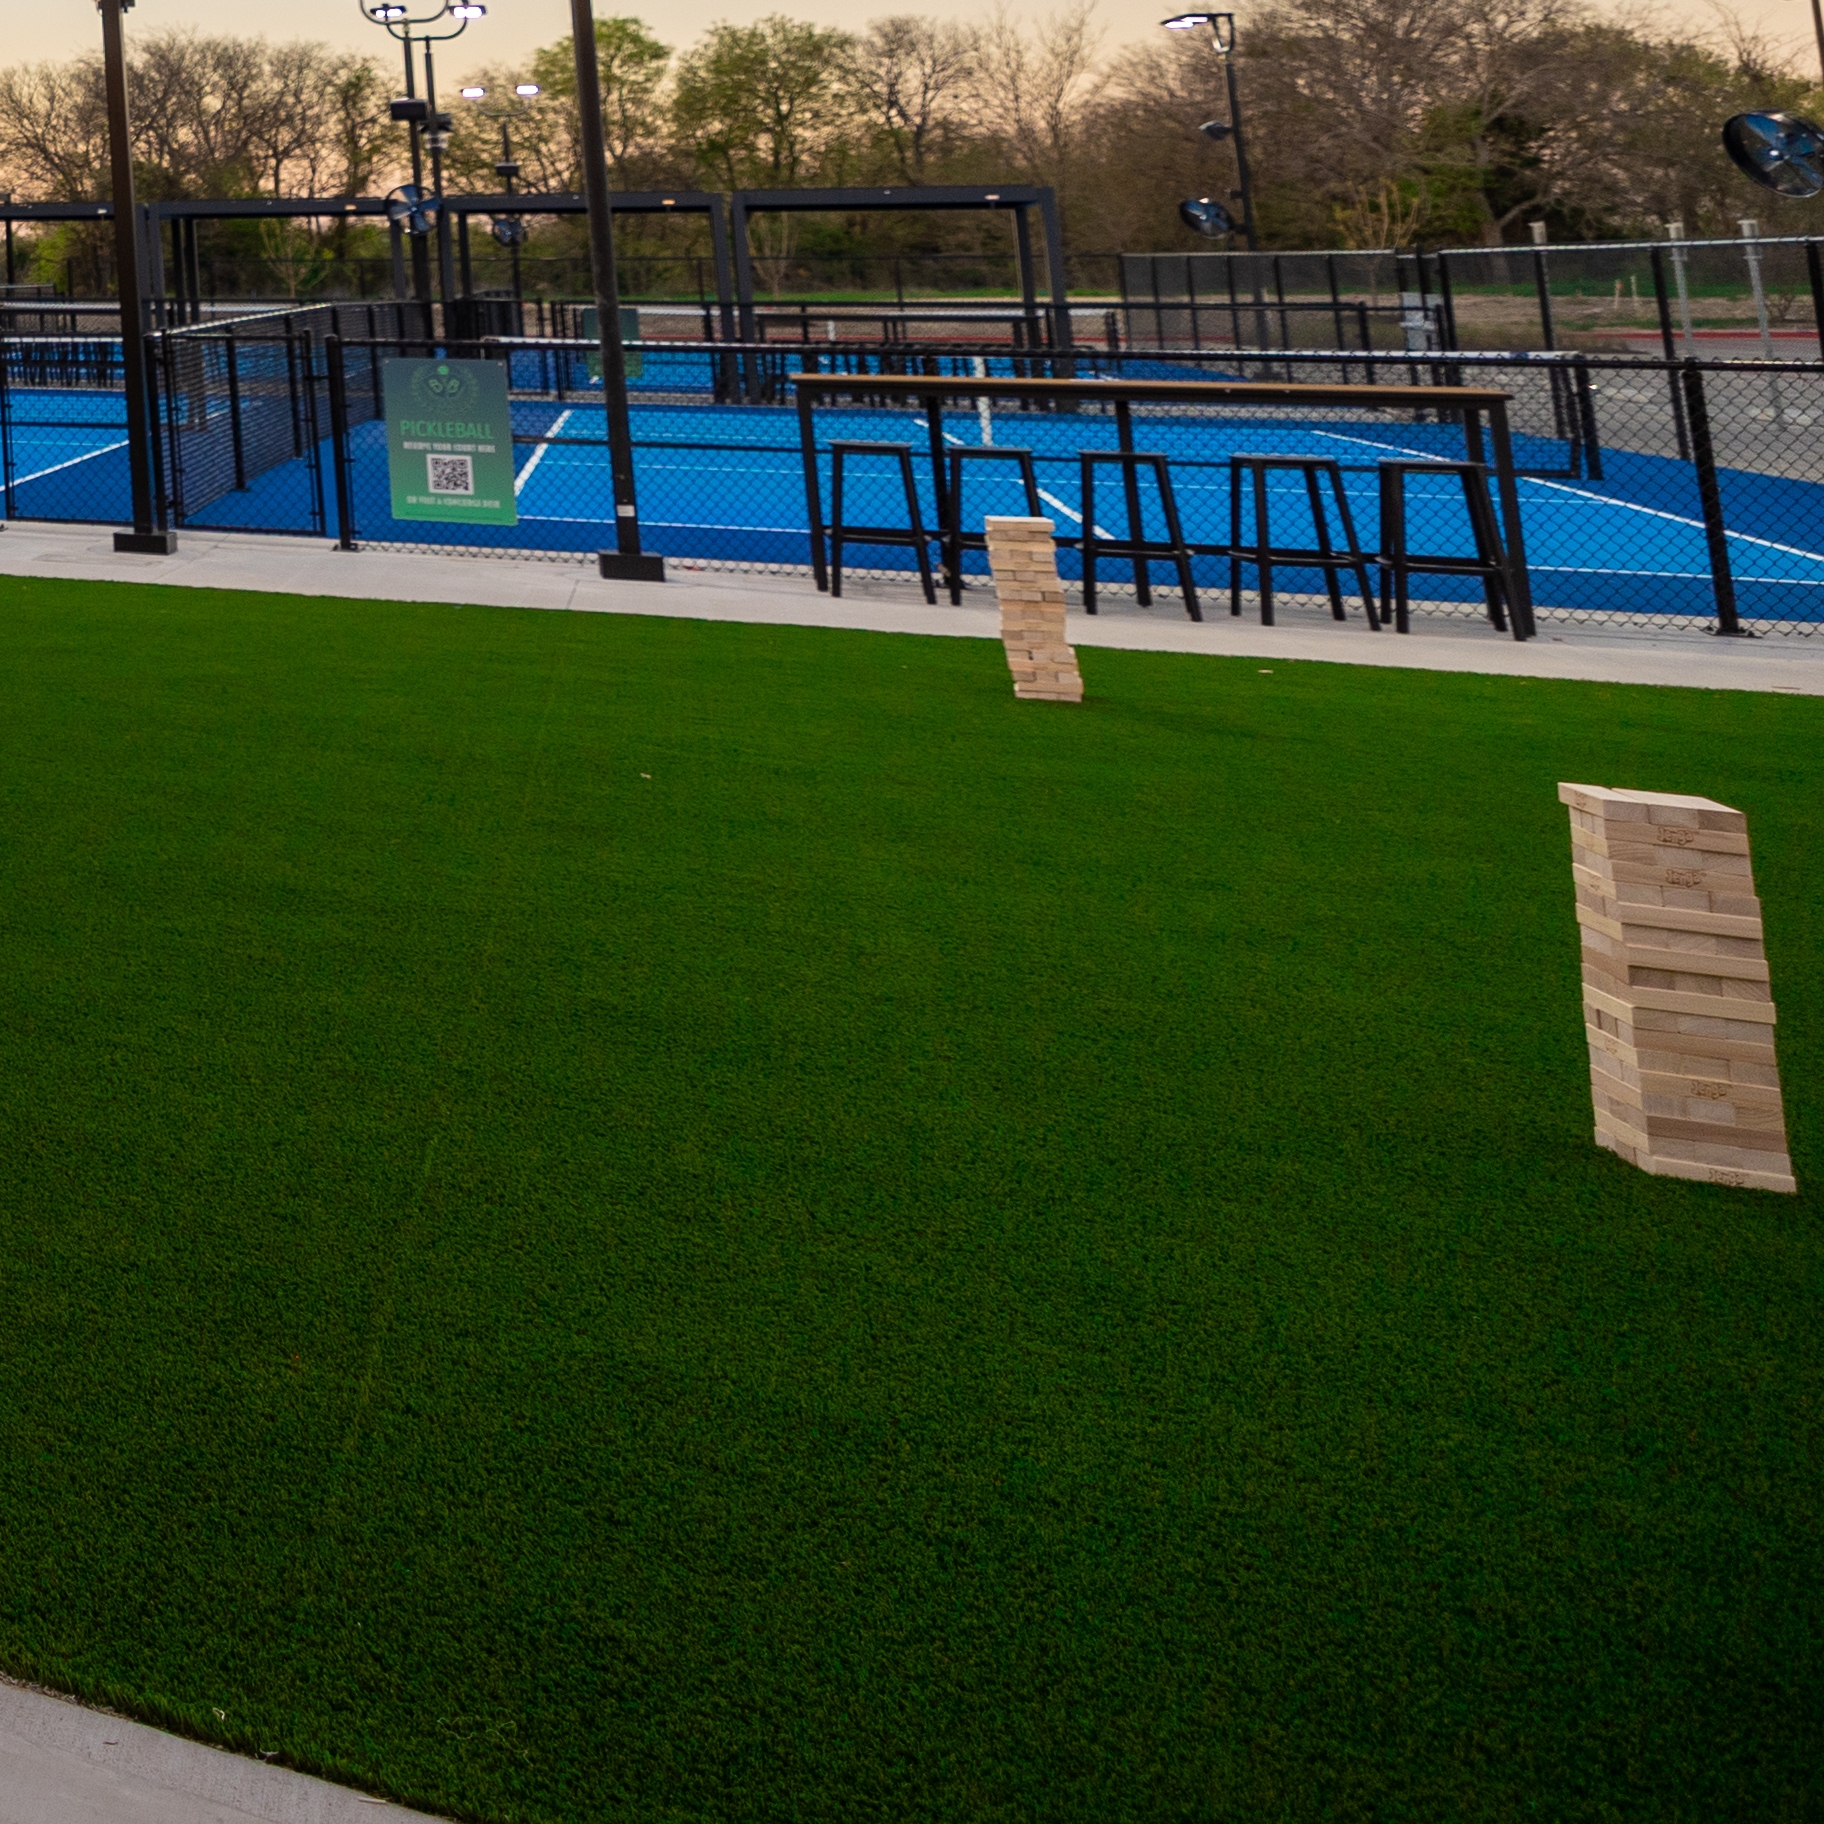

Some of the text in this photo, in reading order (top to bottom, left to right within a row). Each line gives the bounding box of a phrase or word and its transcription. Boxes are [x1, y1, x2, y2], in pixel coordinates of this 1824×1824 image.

[399, 420, 494, 439] PICKLEBALL
[1657, 826, 1694, 845] Jenga
[1665, 868, 1701, 888] Jenga
[1691, 1080, 1727, 1100] Jenga
[1709, 1167, 1744, 1186] Jenga
